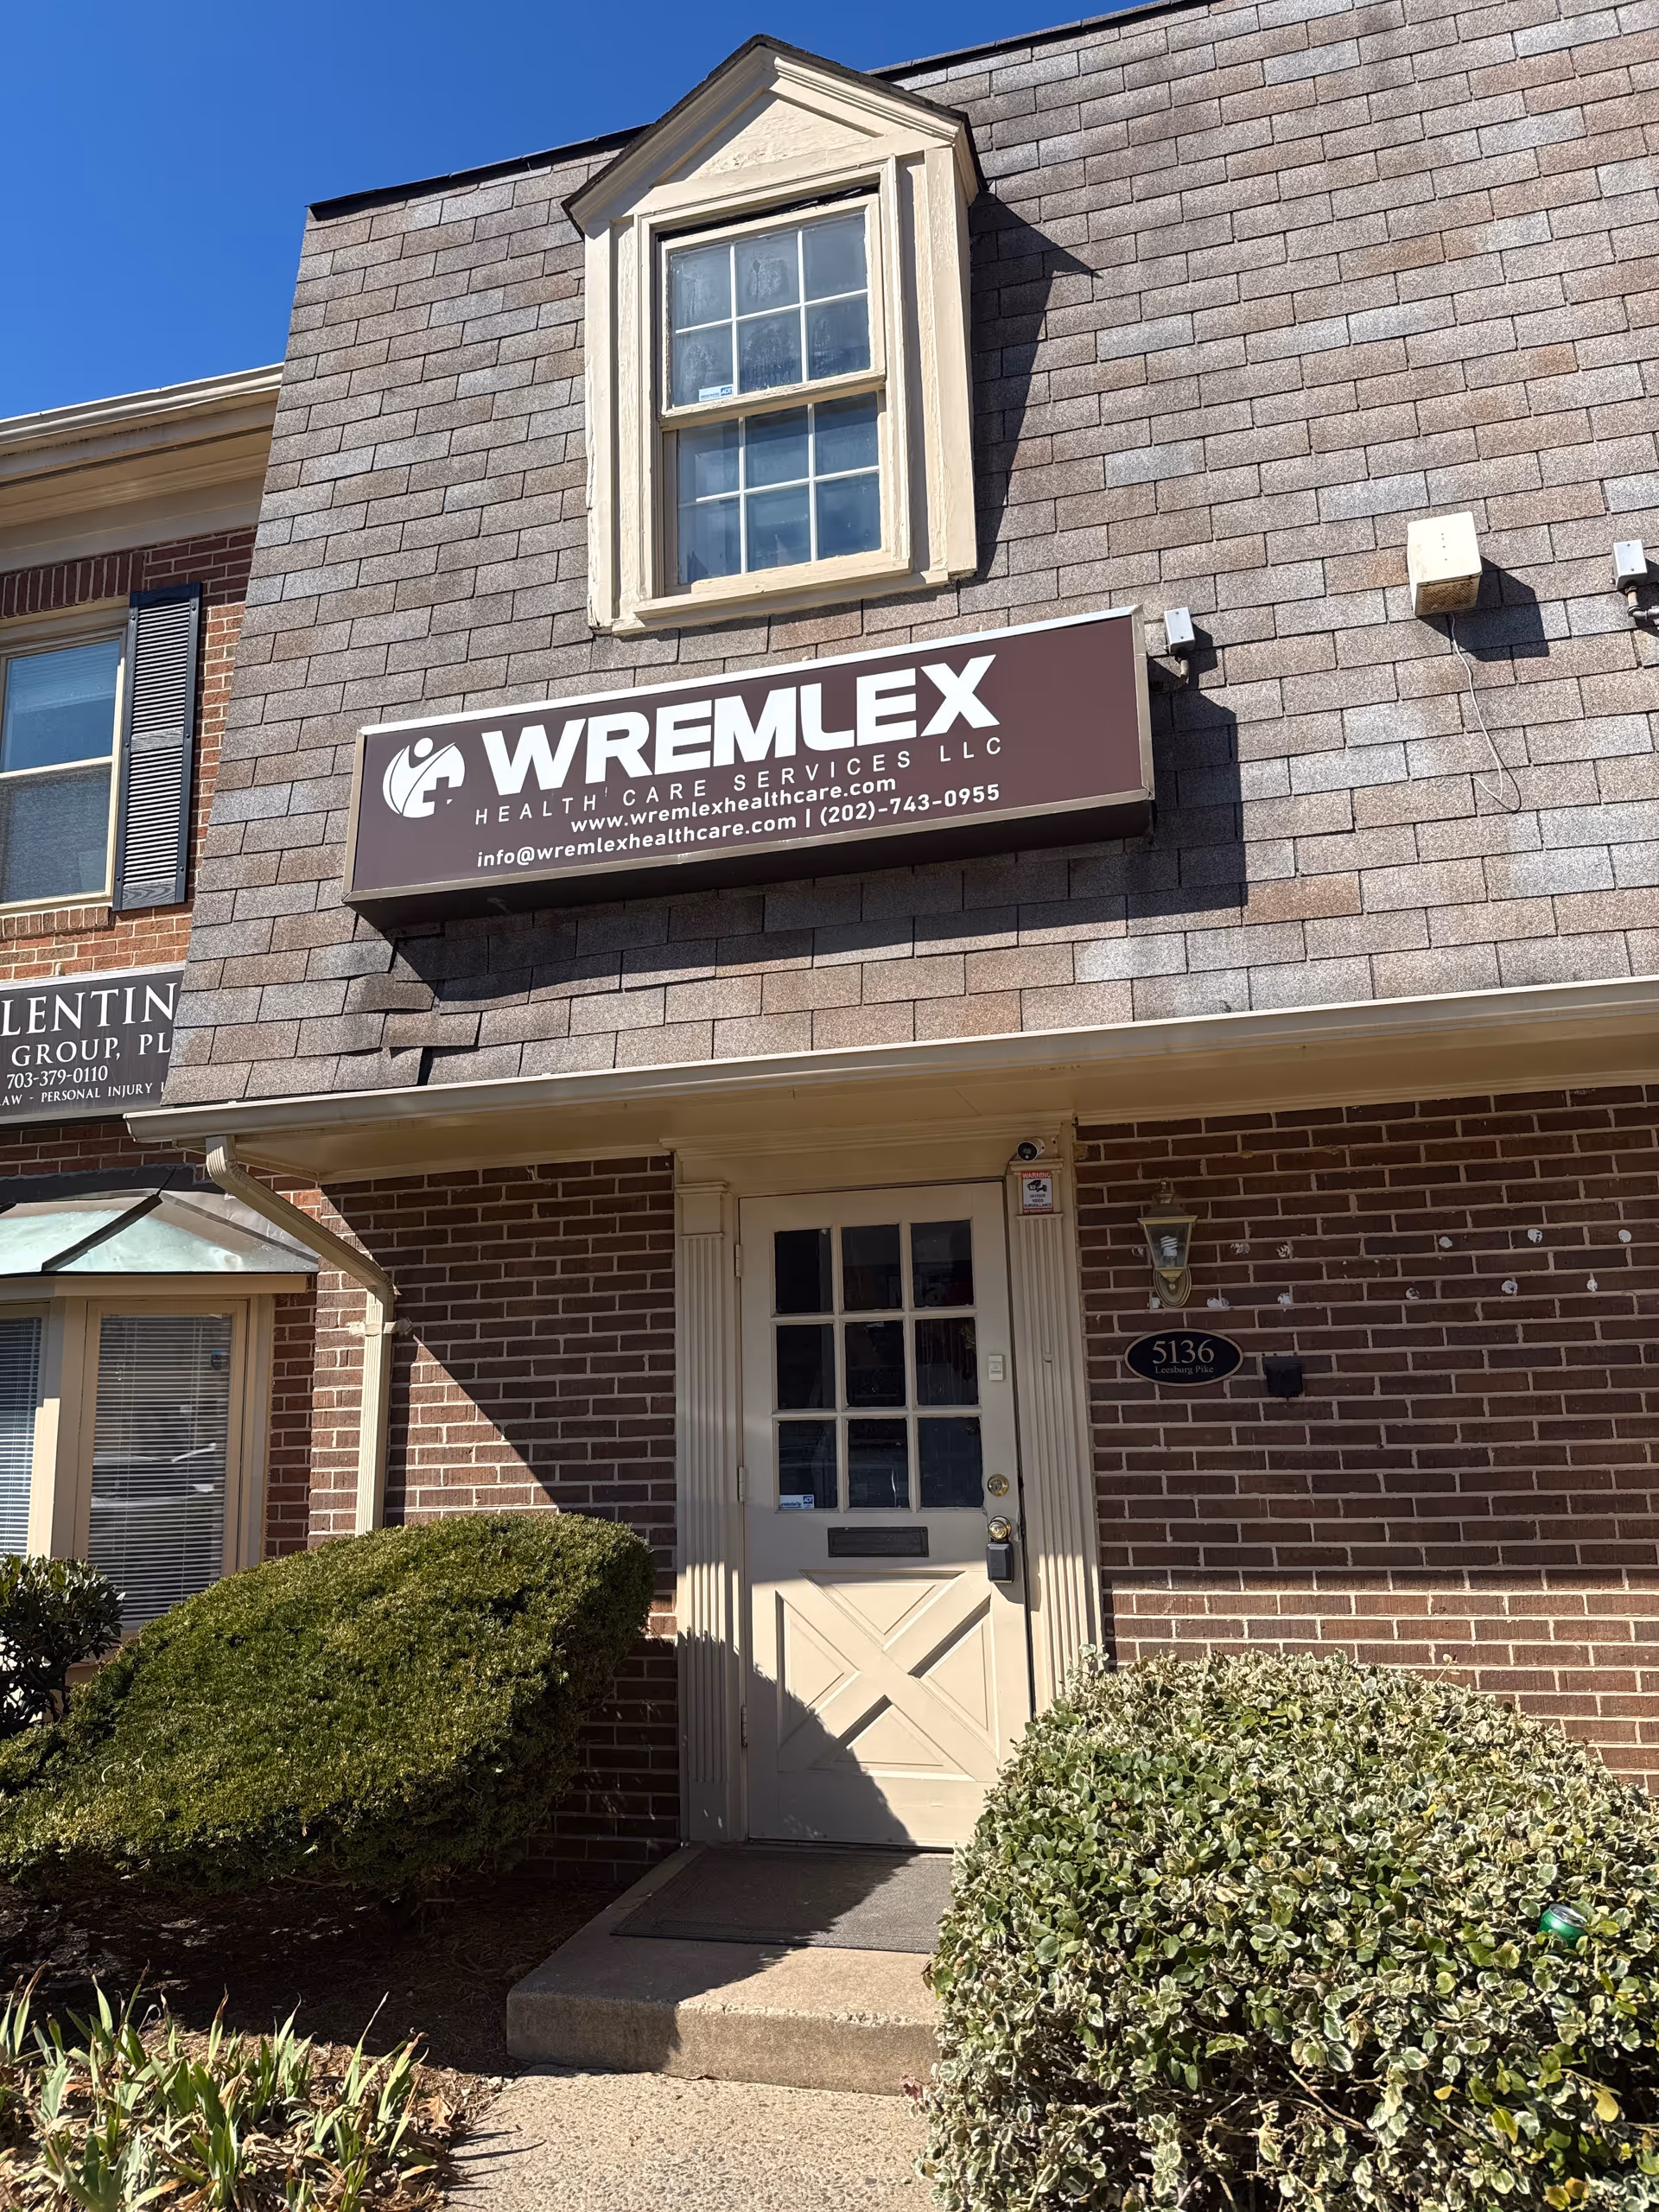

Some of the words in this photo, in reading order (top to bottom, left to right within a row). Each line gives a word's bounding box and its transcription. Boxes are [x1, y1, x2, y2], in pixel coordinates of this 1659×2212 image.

[481, 654, 1000, 796] WREMLEX
[475, 794, 596, 825] HEALTH
[623, 779, 706, 806] CARE
[734, 750, 911, 791] SERVICES
[940, 736, 1001, 763] LLC
[570, 778, 896, 833] www.wremlexhealthcare.com
[477, 814, 797, 868] info@wremlexhealthcare.com
[820, 784, 1000, 827] (202)-743-0955
[11, 1037, 121, 1067] GROUP,
[6, 1065, 109, 1090] 703-379-0110
[0, 1094, 22, 1106] AW
[41, 1087, 101, 1103] PERSONAL
[107, 1082, 154, 1098] INJURY
[1152, 1338, 1215, 1364] 5136
[1155, 1365, 1193, 1375] Leesburg
